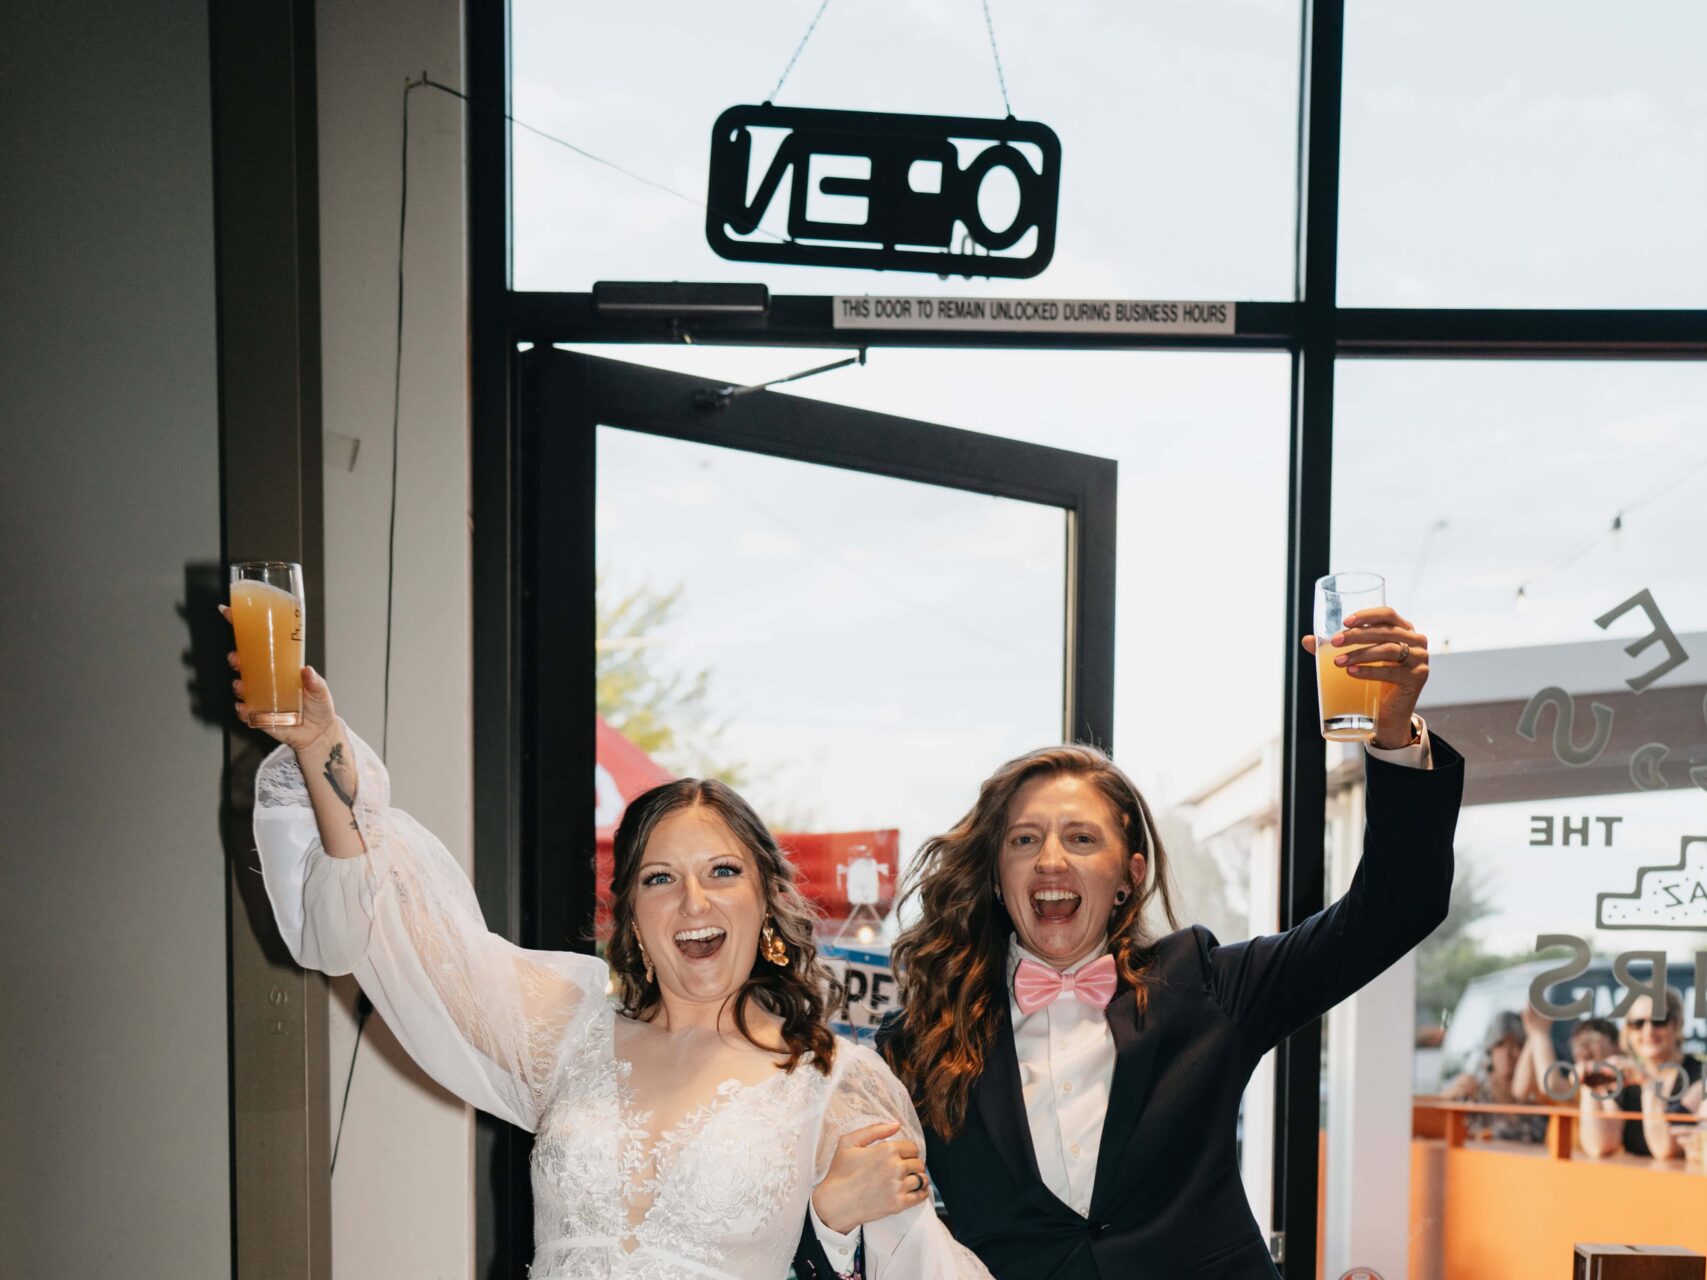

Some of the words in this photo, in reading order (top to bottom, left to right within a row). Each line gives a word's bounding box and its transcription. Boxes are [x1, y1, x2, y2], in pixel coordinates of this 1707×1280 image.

[842, 299, 870, 318] THIS
[875, 300, 911, 319] DOOR
[917, 300, 934, 319] TO
[938, 301, 985, 319] REMAIN
[990, 302, 1058, 321] UNLOCKED
[1063, 303, 1111, 321] DURING
[1116, 303, 1178, 322] BUSINESS
[1183, 304, 1227, 323] HOURS
